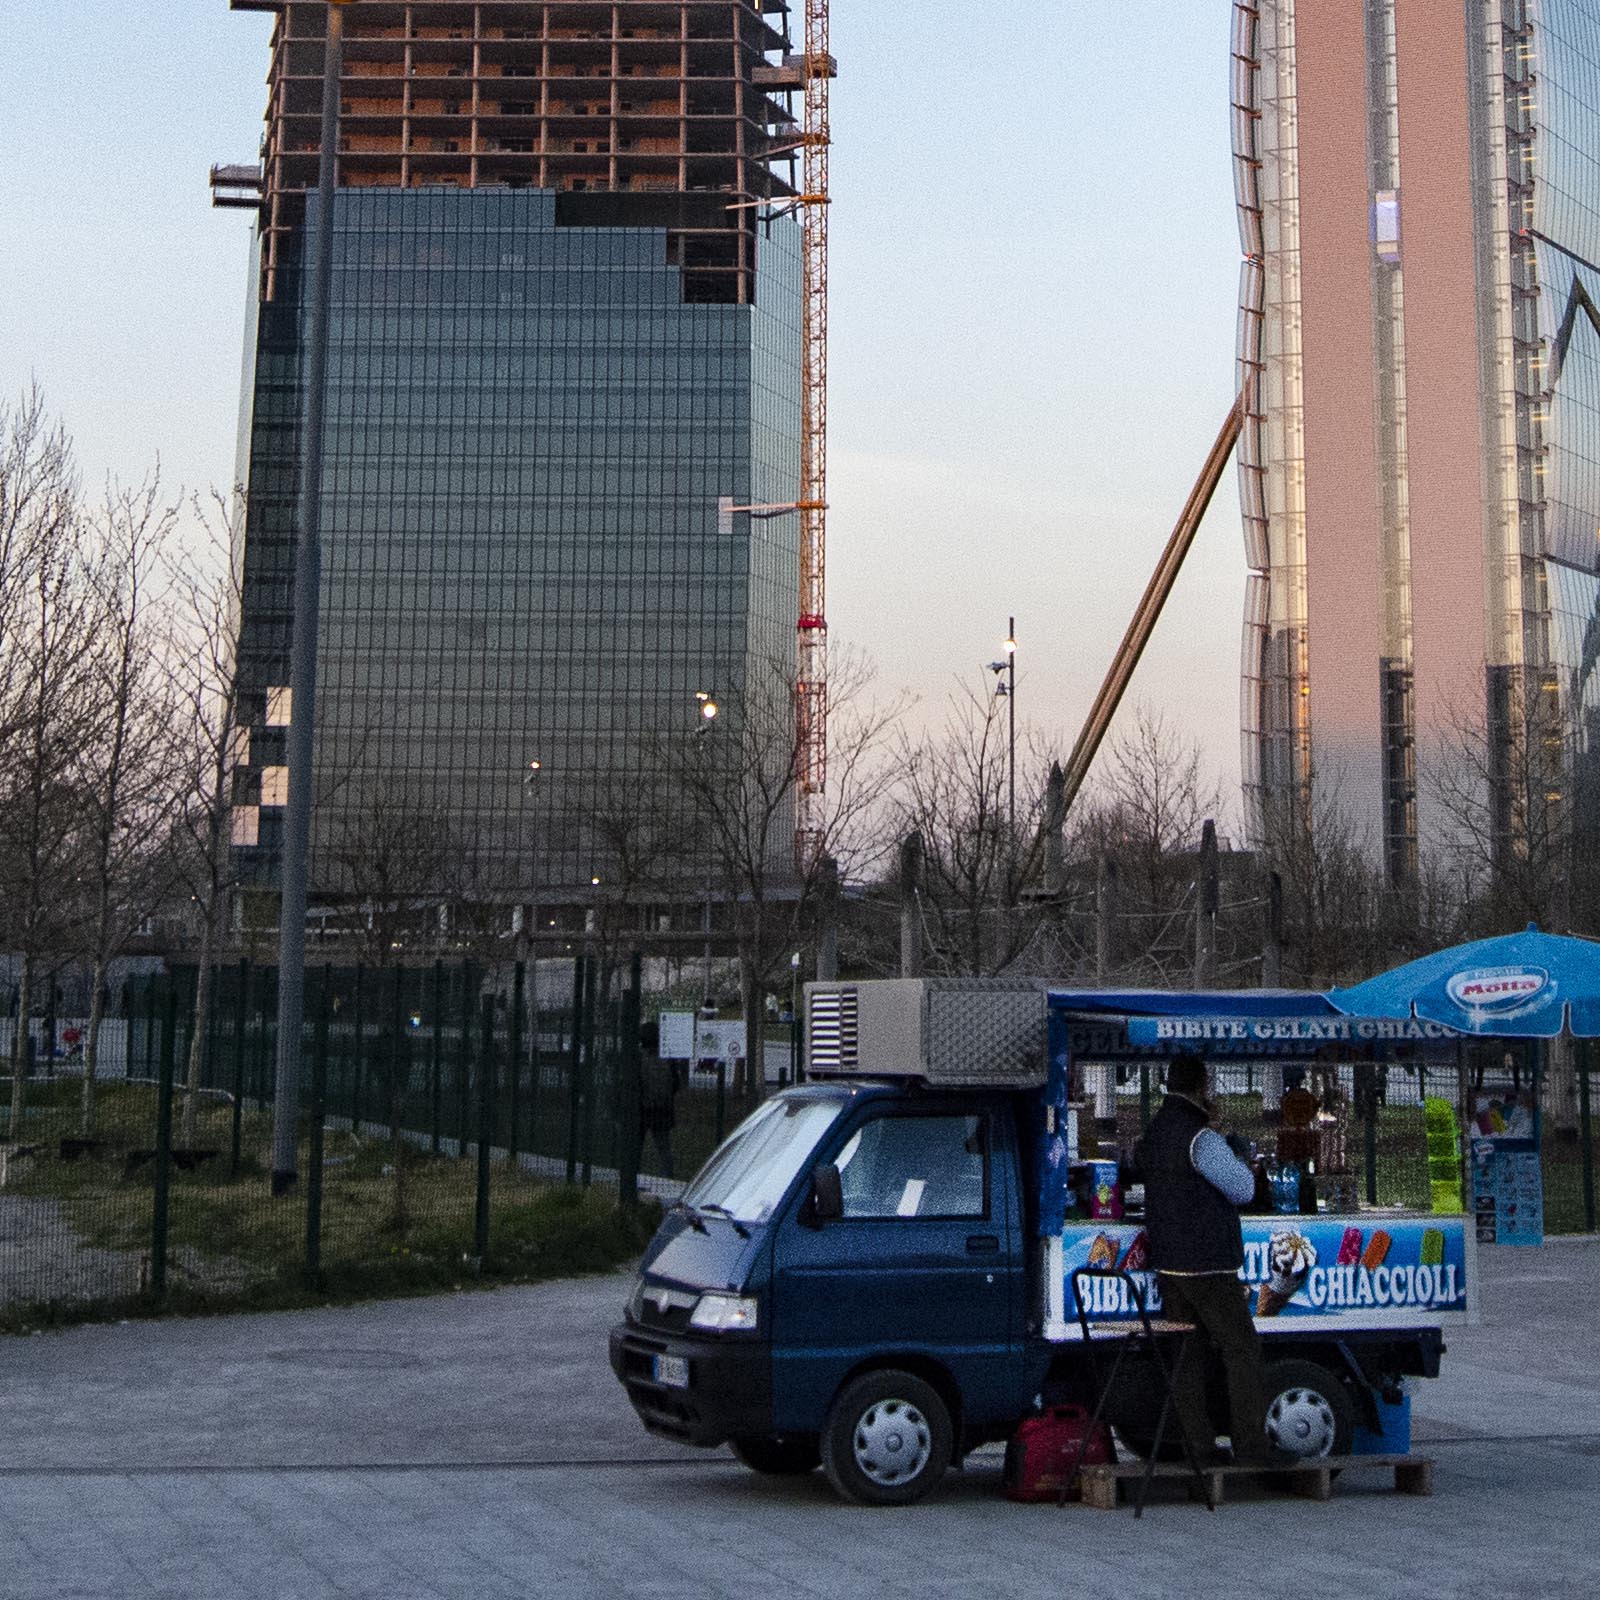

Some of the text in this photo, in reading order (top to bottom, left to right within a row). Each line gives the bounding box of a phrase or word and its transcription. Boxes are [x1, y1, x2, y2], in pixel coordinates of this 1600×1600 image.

[1461, 979, 1538, 996] Motta
[1156, 1020, 1248, 1039] BIBITE
[1253, 1019, 1351, 1039] GELATI
[1308, 1263, 1458, 1307] GHIACCIOLI
